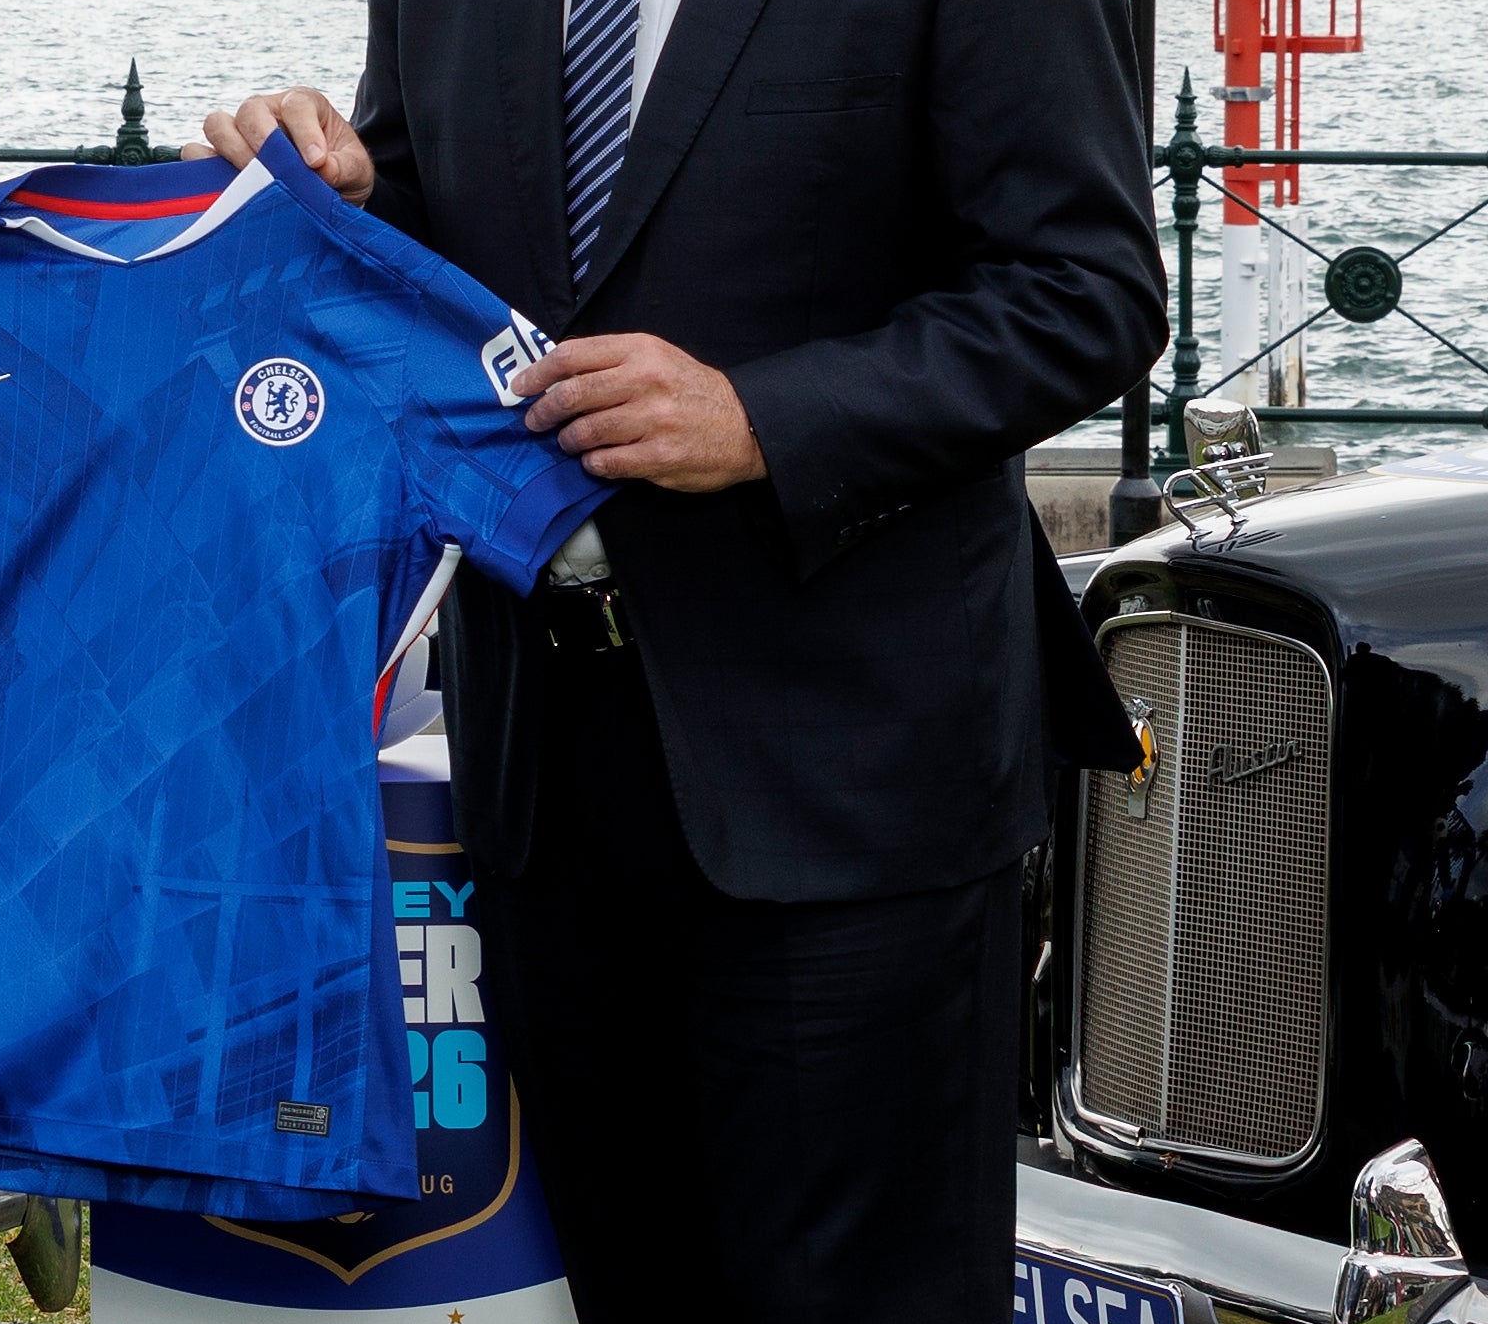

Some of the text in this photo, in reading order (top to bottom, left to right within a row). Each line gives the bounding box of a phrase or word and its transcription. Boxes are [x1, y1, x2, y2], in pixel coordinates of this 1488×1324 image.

[257, 365, 310, 387] CHELSEA
[249, 420, 303, 439] FOOTBALL CLUB
